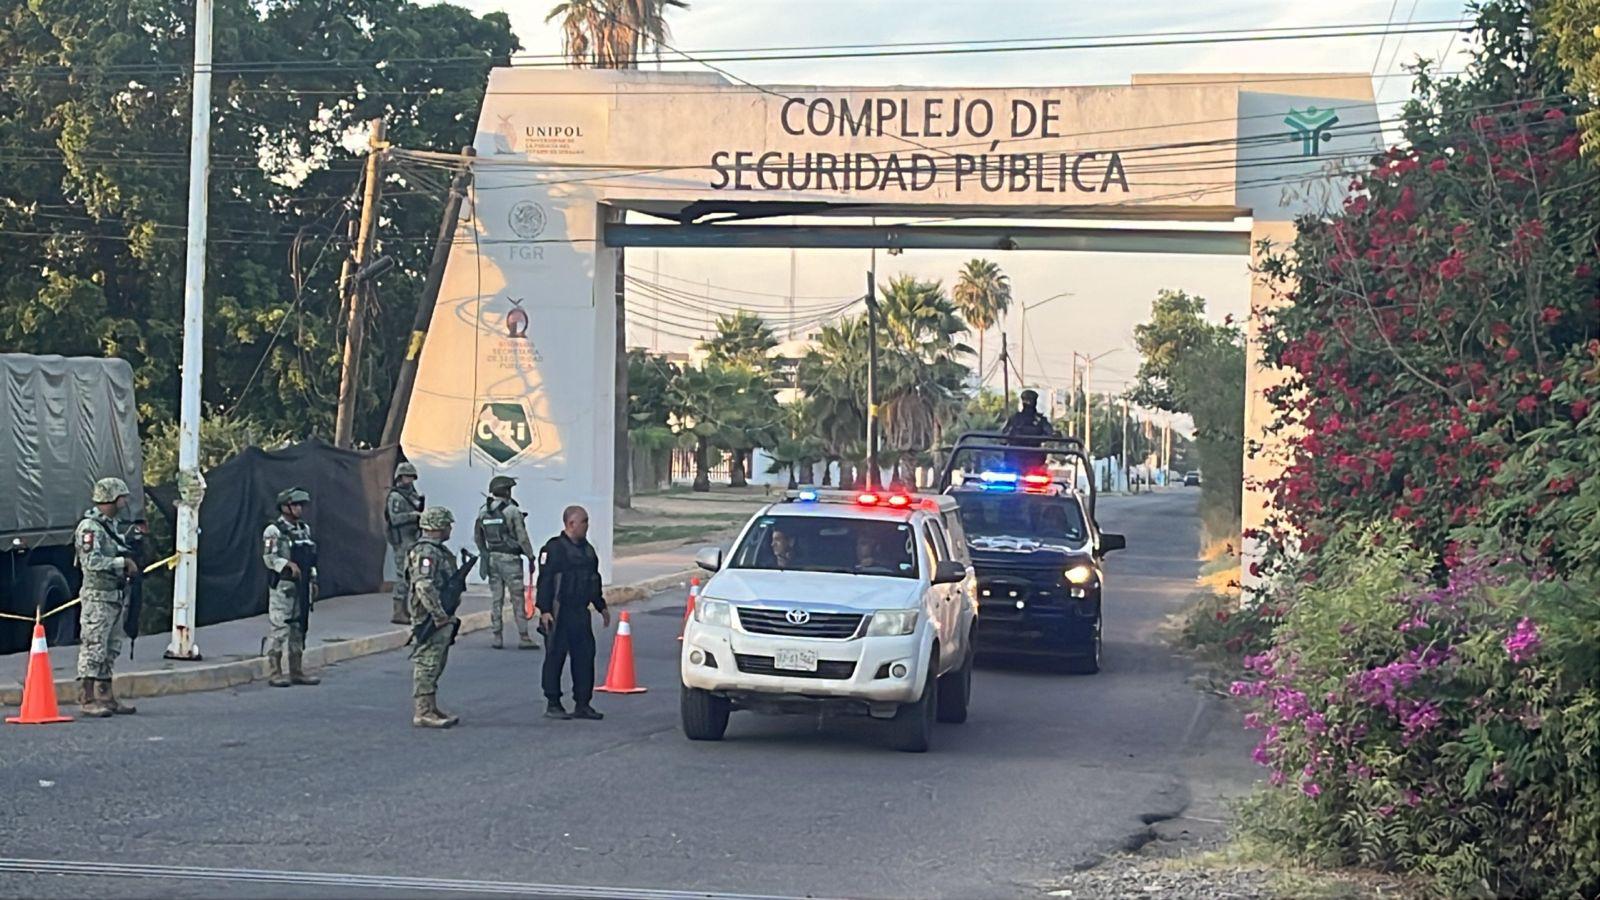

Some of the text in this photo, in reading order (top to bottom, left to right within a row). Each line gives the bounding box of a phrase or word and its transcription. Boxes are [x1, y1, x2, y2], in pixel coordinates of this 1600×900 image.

[780, 97, 1061, 138] COMPLEJO DE
[525, 125, 584, 137] UNIPOL
[710, 140, 1130, 193] SEGURIDAD PÚBLICA
[509, 245, 545, 260] FGR
[477, 419, 525, 441] C4i
